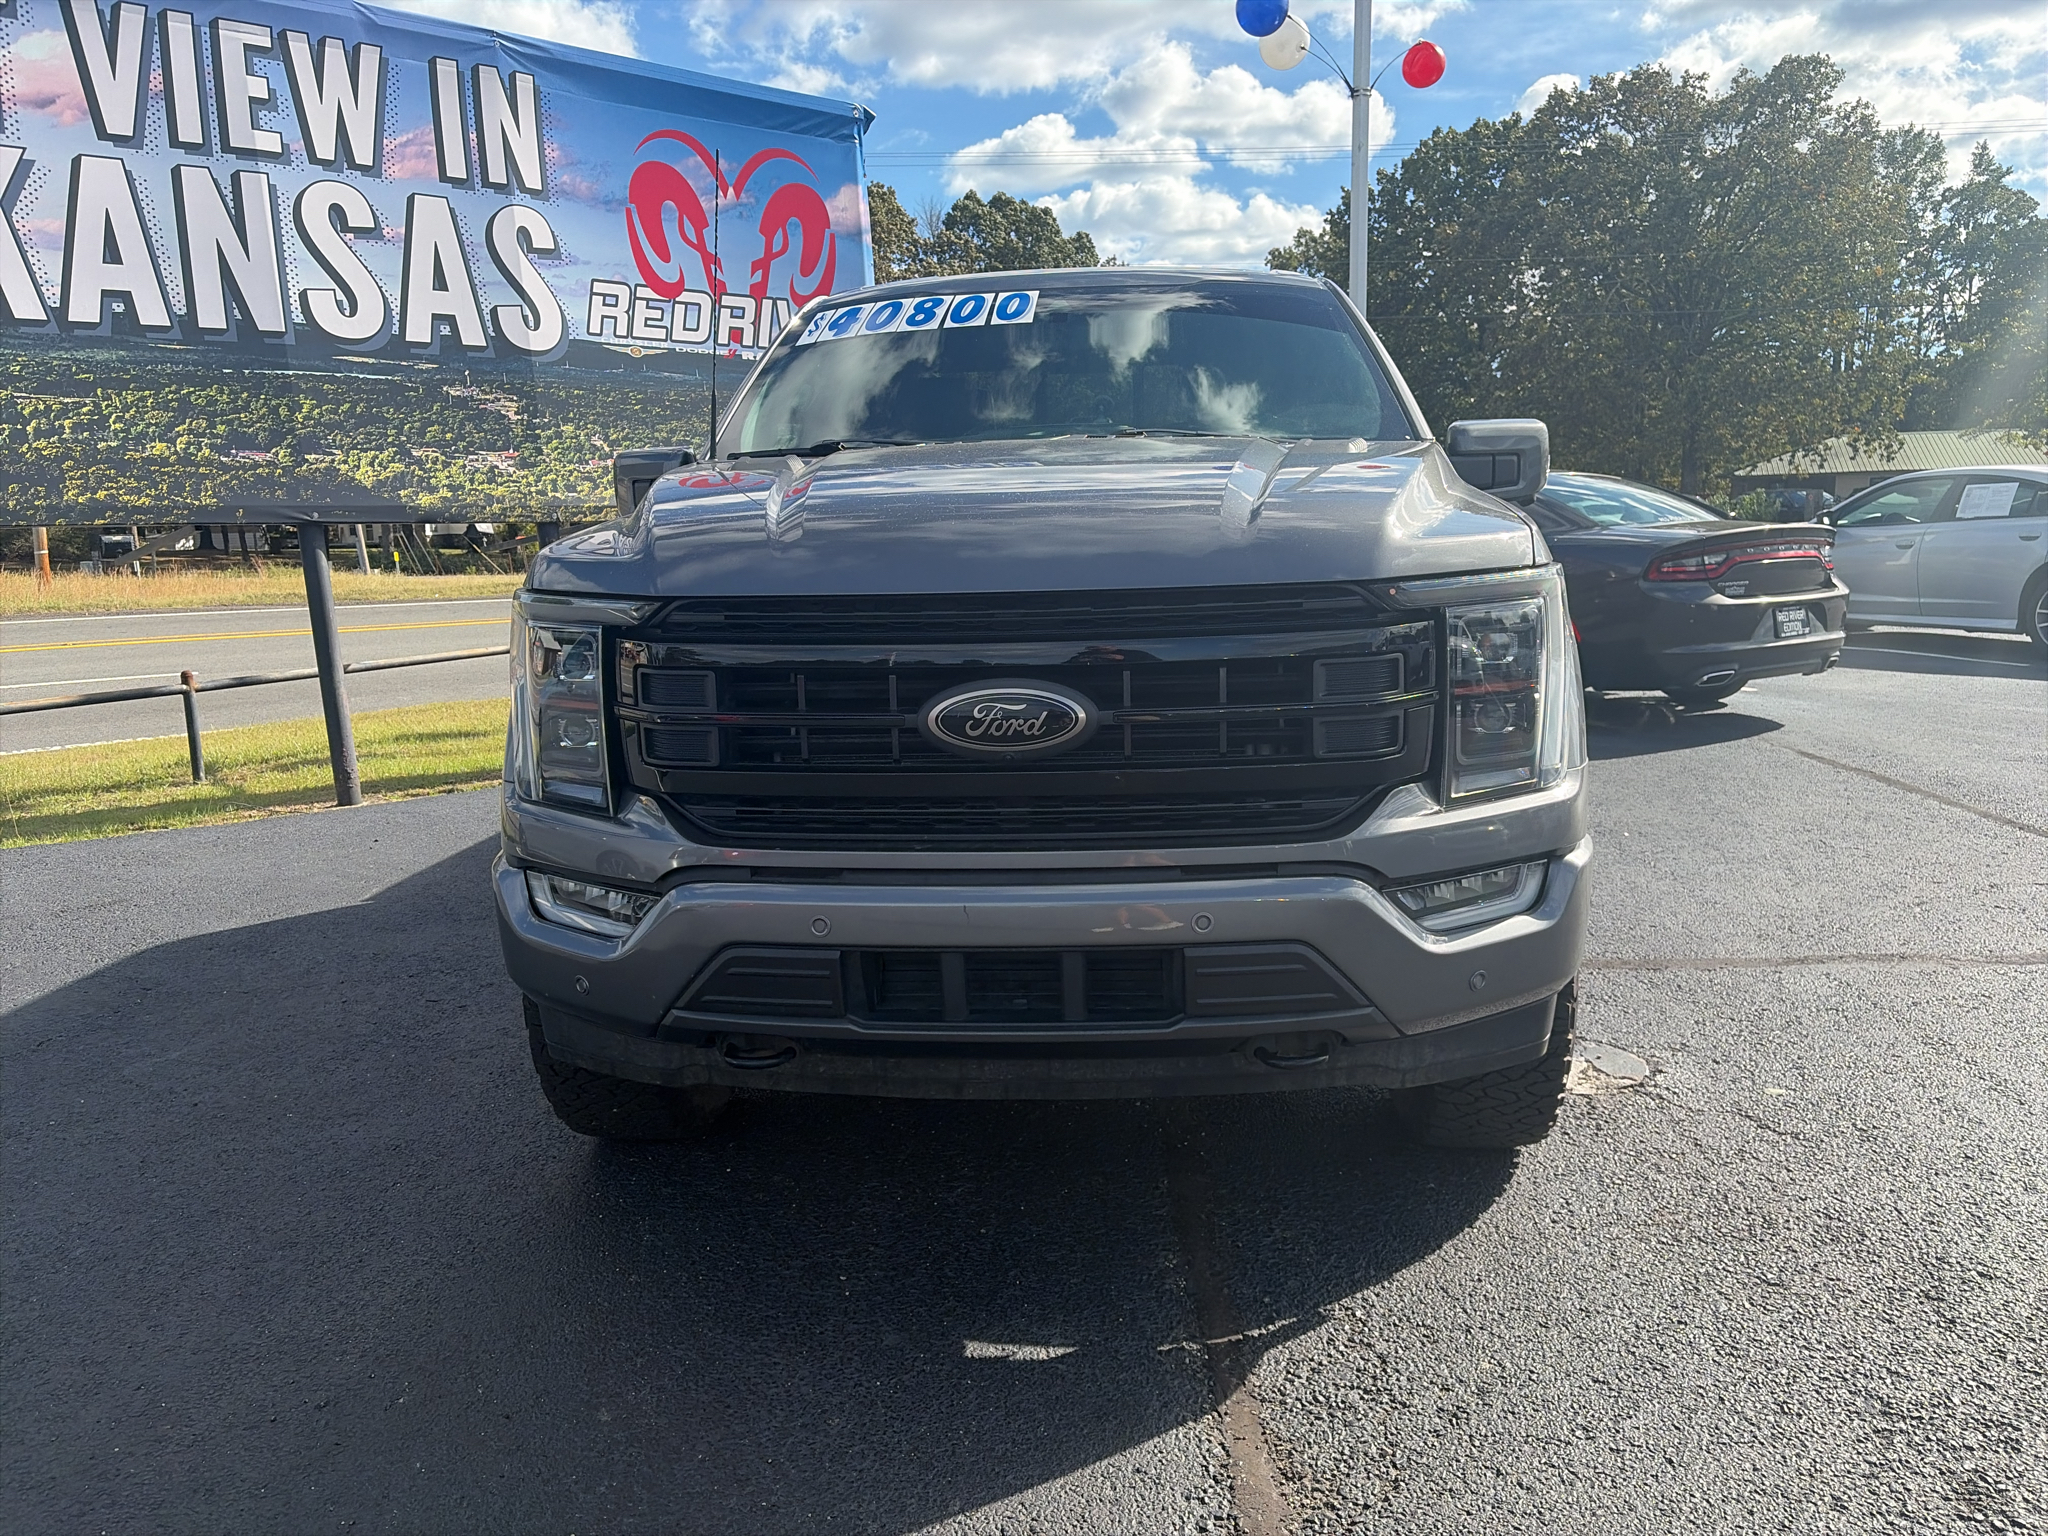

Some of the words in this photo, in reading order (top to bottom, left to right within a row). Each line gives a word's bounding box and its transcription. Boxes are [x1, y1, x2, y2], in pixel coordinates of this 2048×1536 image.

[62, 0, 383, 168] VIEW
[428, 56, 549, 194] IN
[807, 292, 1031, 338] $40800
[965, 702, 1049, 737] Ford
